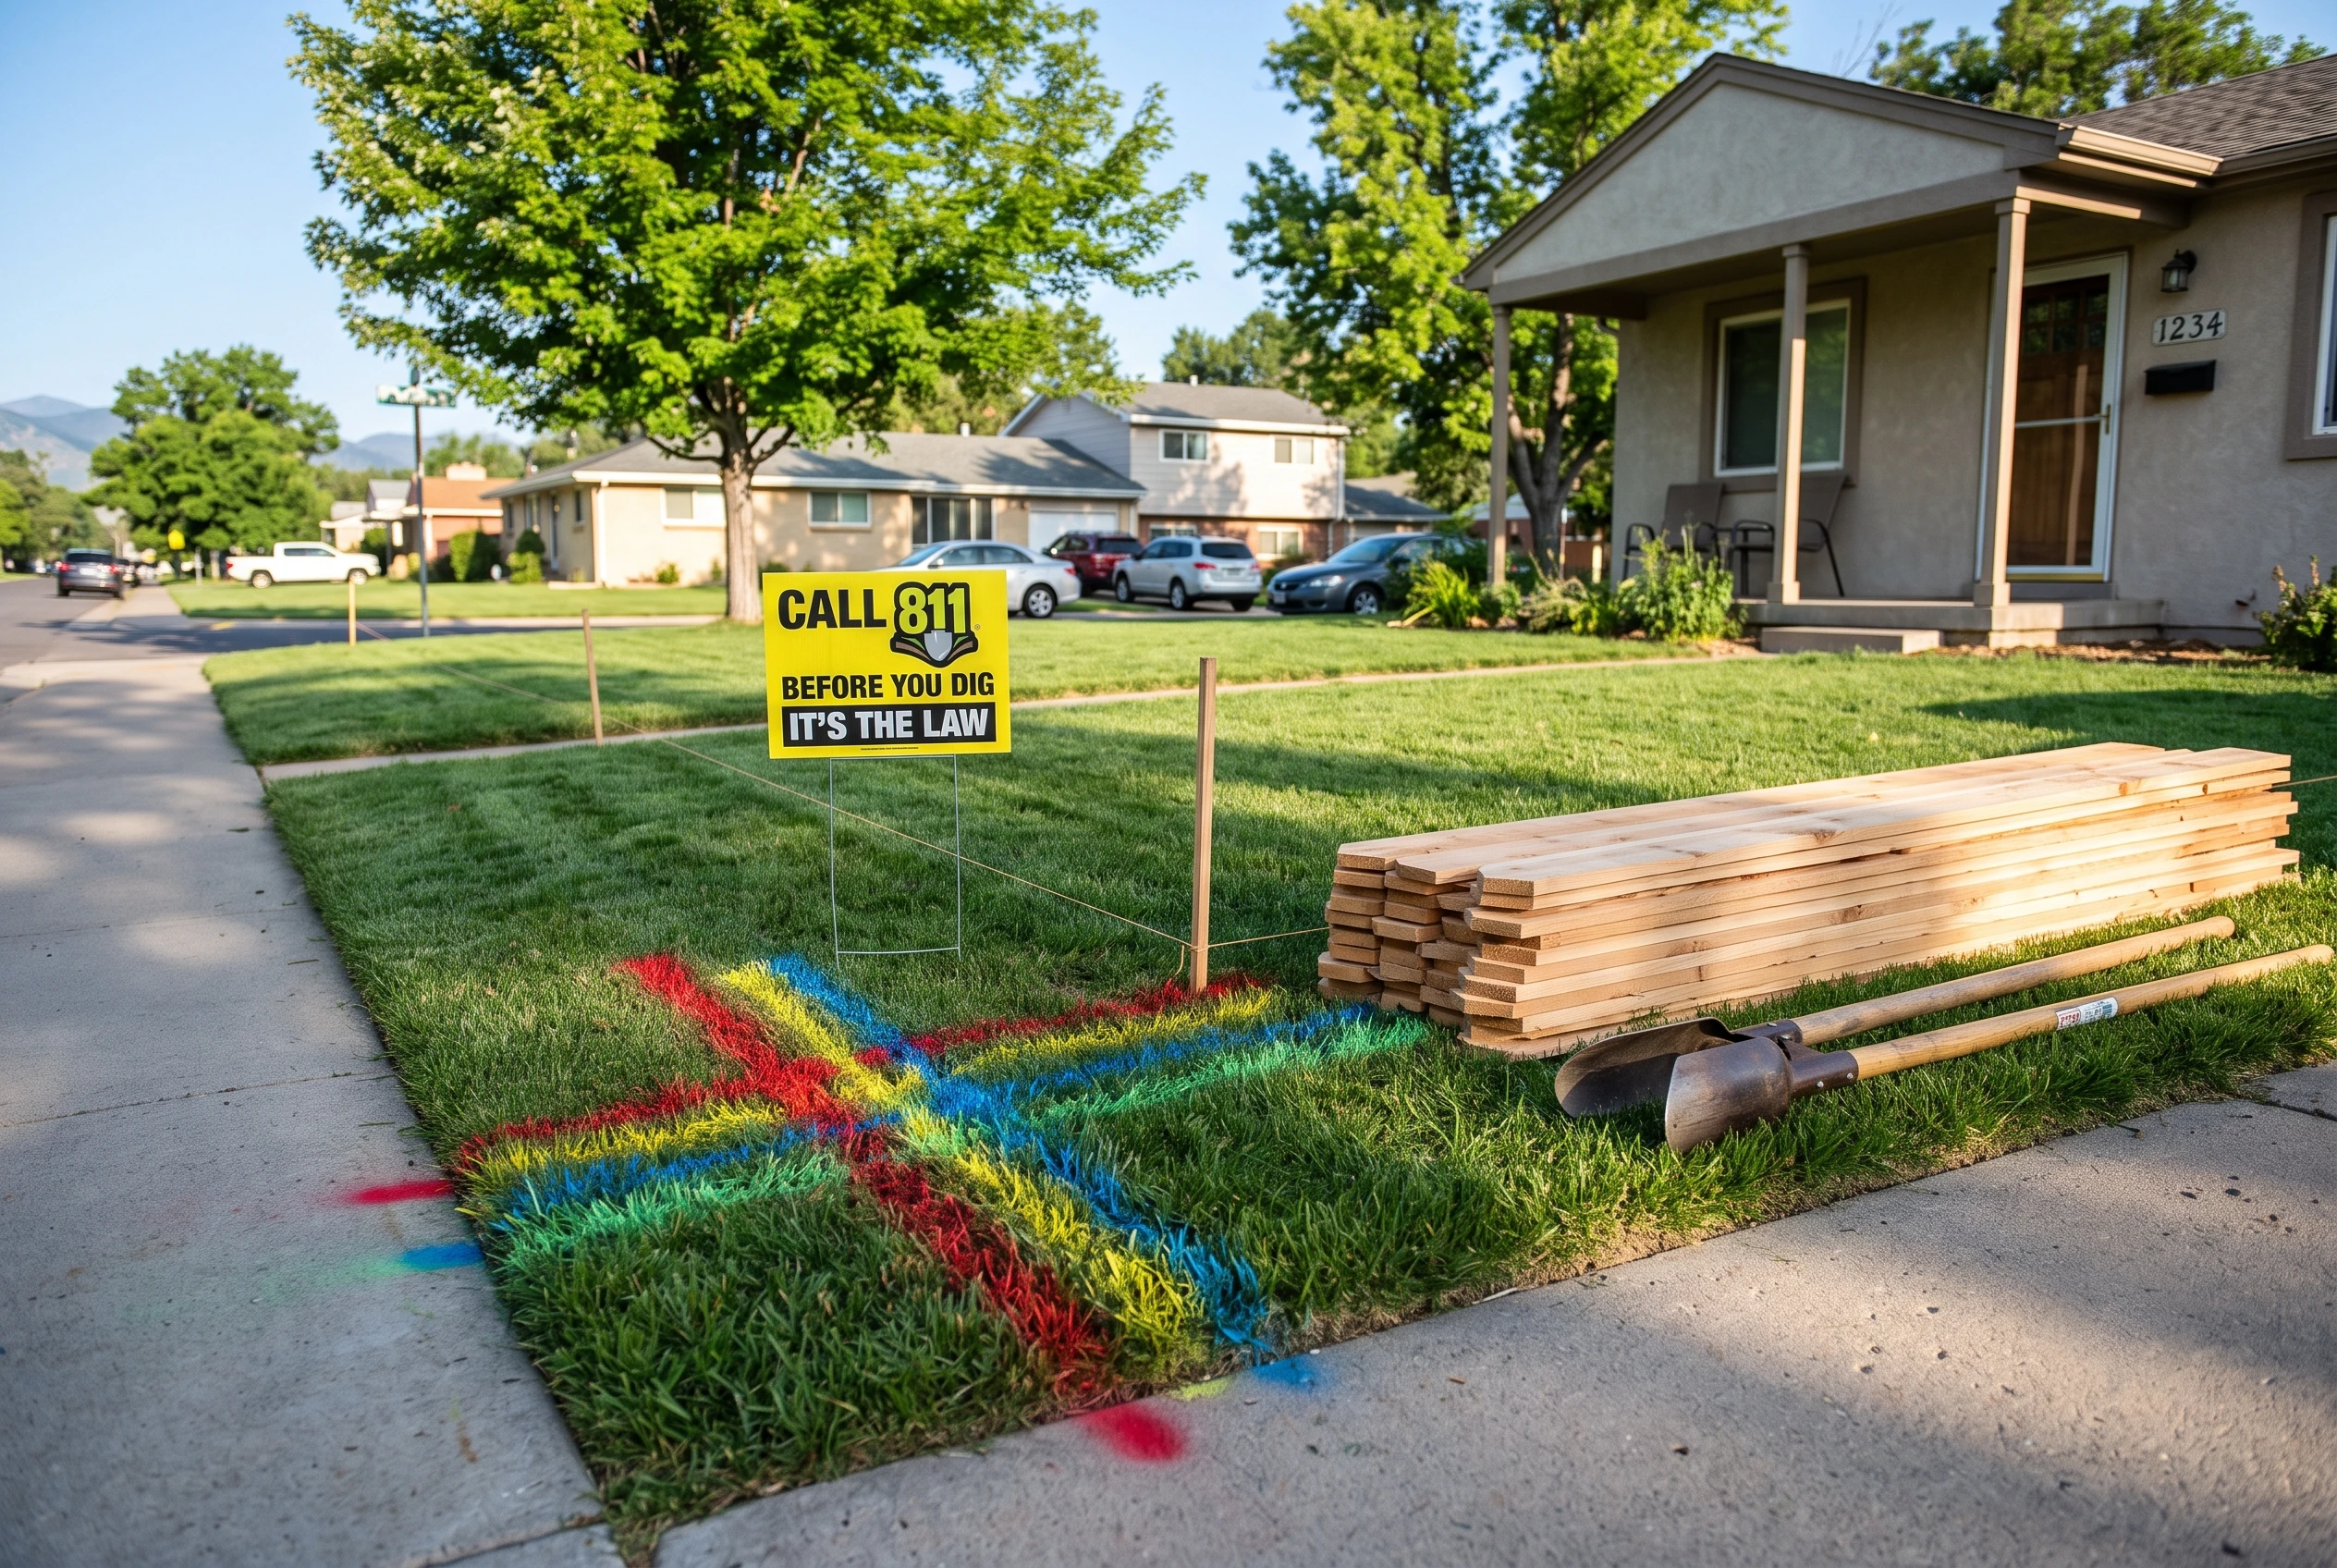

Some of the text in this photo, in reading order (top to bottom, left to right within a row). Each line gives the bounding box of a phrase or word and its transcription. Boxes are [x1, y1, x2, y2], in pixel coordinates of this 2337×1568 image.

[2160, 311, 2222, 342] 1234
[778, 587, 966, 635] CALL 811
[782, 671, 995, 700] BEFORE YOU DIG
[789, 708, 989, 741] IT'S THE LAW
